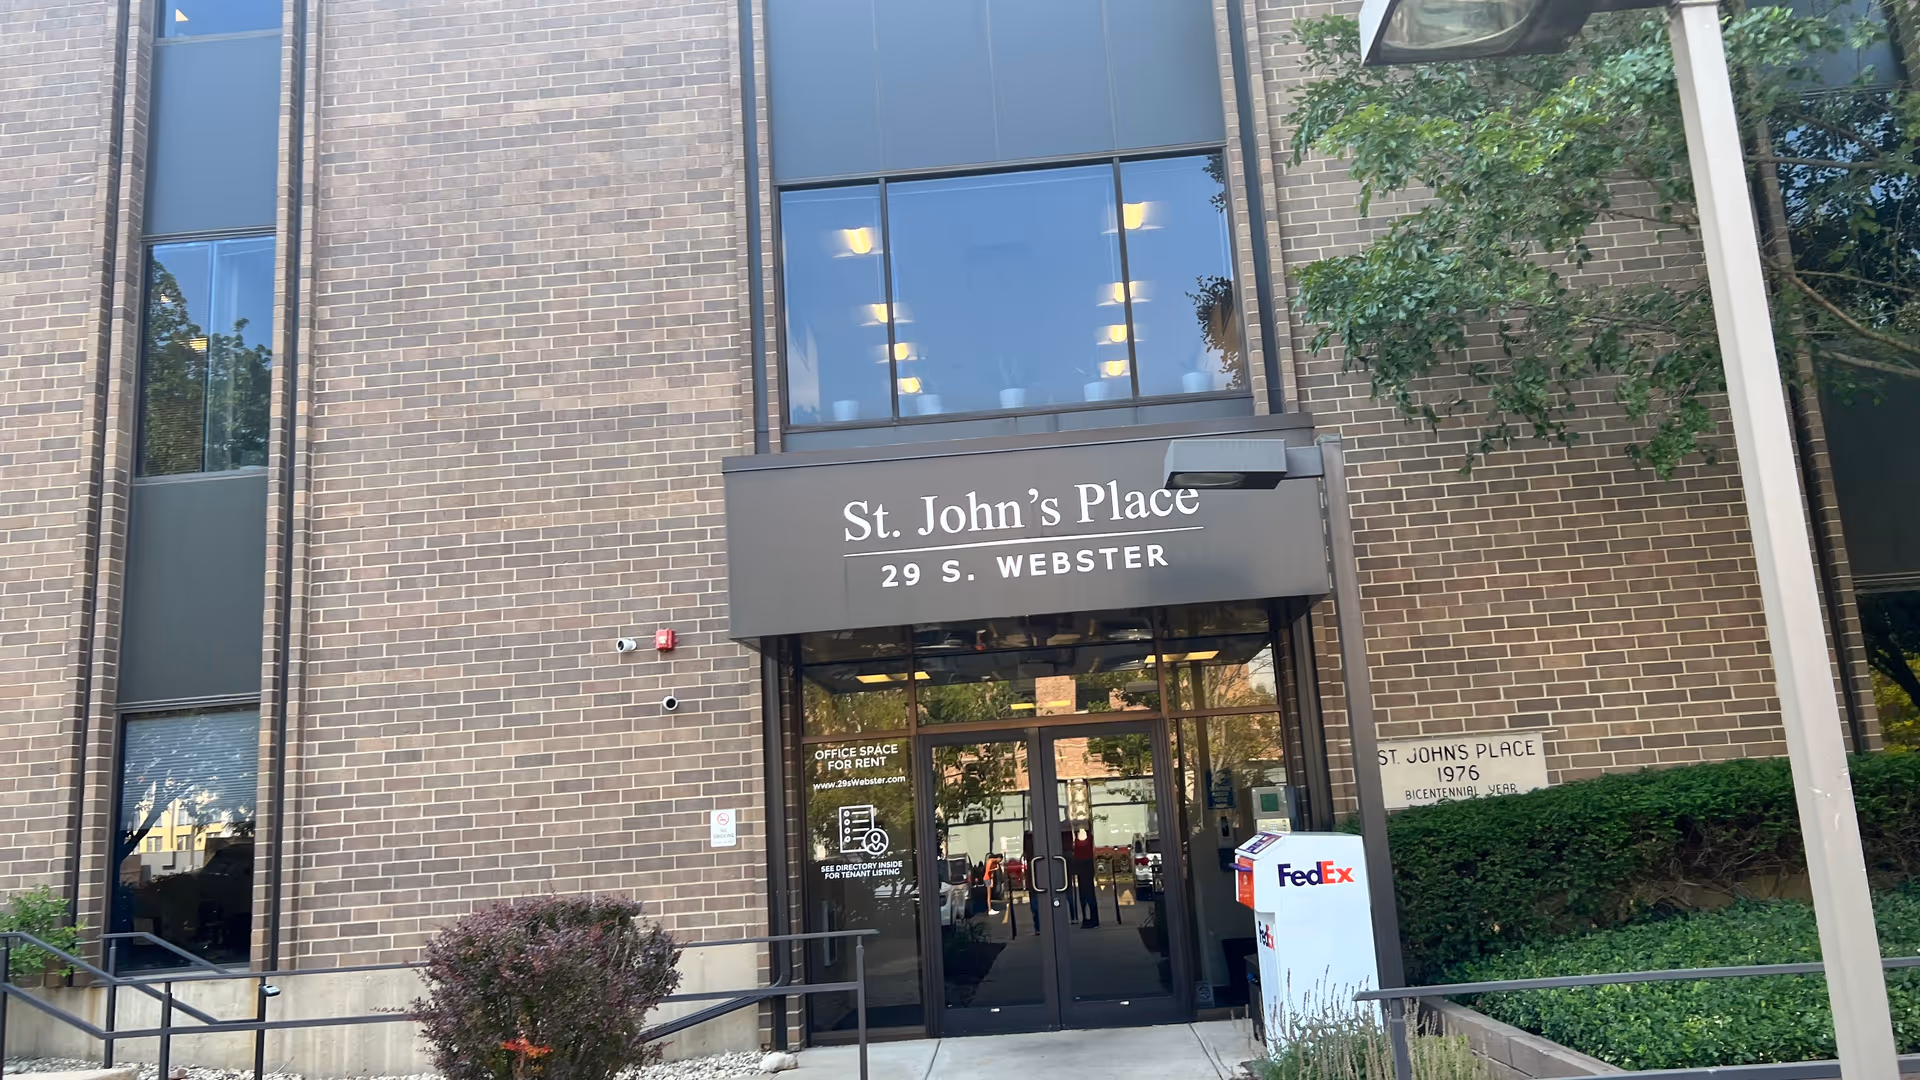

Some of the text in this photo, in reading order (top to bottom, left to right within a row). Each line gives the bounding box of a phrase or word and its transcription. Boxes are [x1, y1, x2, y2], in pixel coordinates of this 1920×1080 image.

[843, 479, 1200, 542] St. John's Place
[881, 544, 1169, 588] 29 S. WEBSTER
[815, 744, 898, 760] OFFICE SPACE
[1377, 749, 1401, 766] ST.
[1476, 739, 1536, 759] PLACE
[828, 757, 886, 771] FOR RENT
[813, 776, 905, 789] www.29sWebster.com
[1437, 764, 1480, 783] 1976
[1405, 783, 1518, 801] BICENTENNIAL YEAR
[821, 861, 903, 873] SEE DIRECTORY INSIDE
[842, 870, 870, 878] TENANT
[872, 868, 900, 876] LISTING
[1277, 860, 1355, 887] FedEx
[1258, 920, 1276, 951] FedEx
